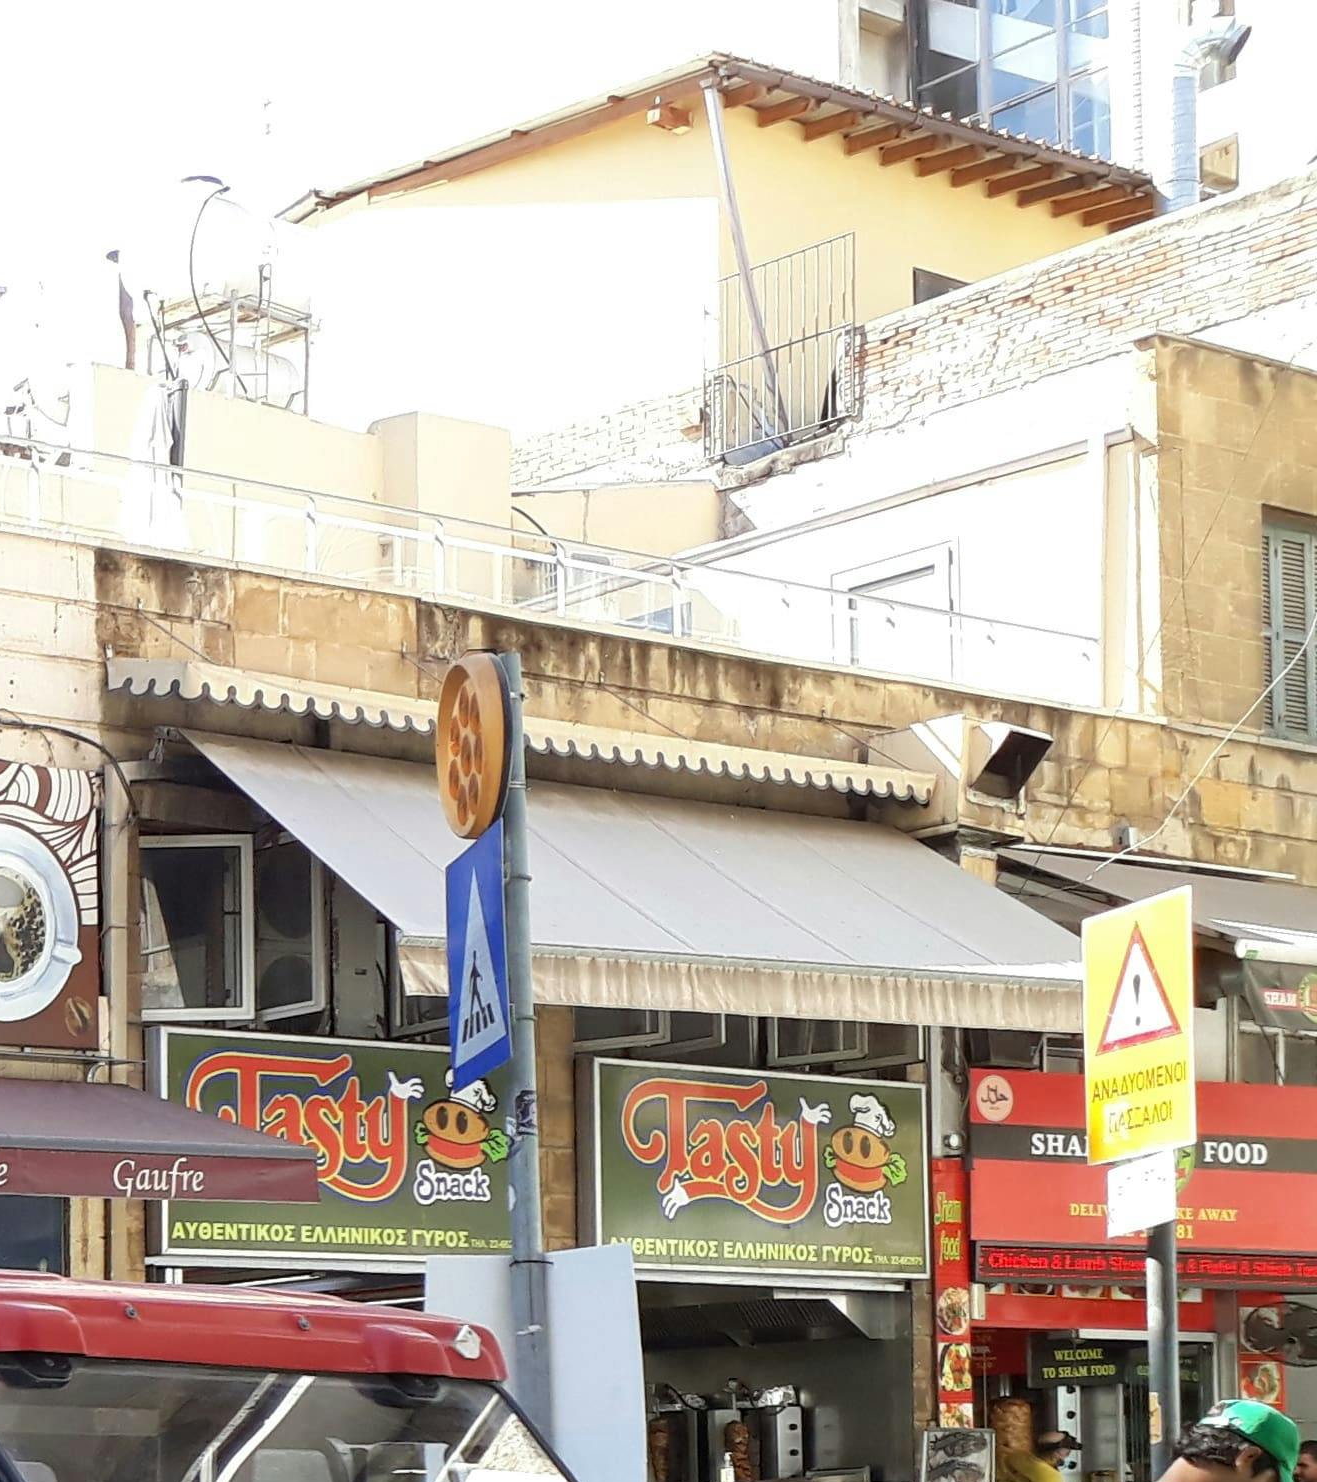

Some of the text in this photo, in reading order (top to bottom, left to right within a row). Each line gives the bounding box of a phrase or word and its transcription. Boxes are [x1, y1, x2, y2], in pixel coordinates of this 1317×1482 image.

[1092, 1061, 1187, 1104] ΑΝΑΔΥΟΜΕΝΟΙ
[621, 1077, 819, 1224] Tasty
[1031, 1133, 1269, 1166] SHA FOOD
[111, 1159, 205, 1197] Gaufre
[415, 1163, 491, 1205] Snack
[823, 1182, 892, 1227] Snack
[1197, 1209, 1238, 1222] AWAY
[172, 1221, 295, 1243] ΑΥΘΕΝΤΙΚΟΣ
[301, 1229, 408, 1247] ΕΛΛΗΝΙΚΟΣ
[412, 1231, 469, 1248] ΓΥΡΟΣ
[723, 1241, 818, 1261] ΕΛΛΗΝΙΚΟΣ
[822, 1246, 873, 1264] ΓΥΡΟΣ
[1042, 1363, 1117, 1379] TO SHAM FOOD
[1053, 1349, 1104, 1361] WELCOME
